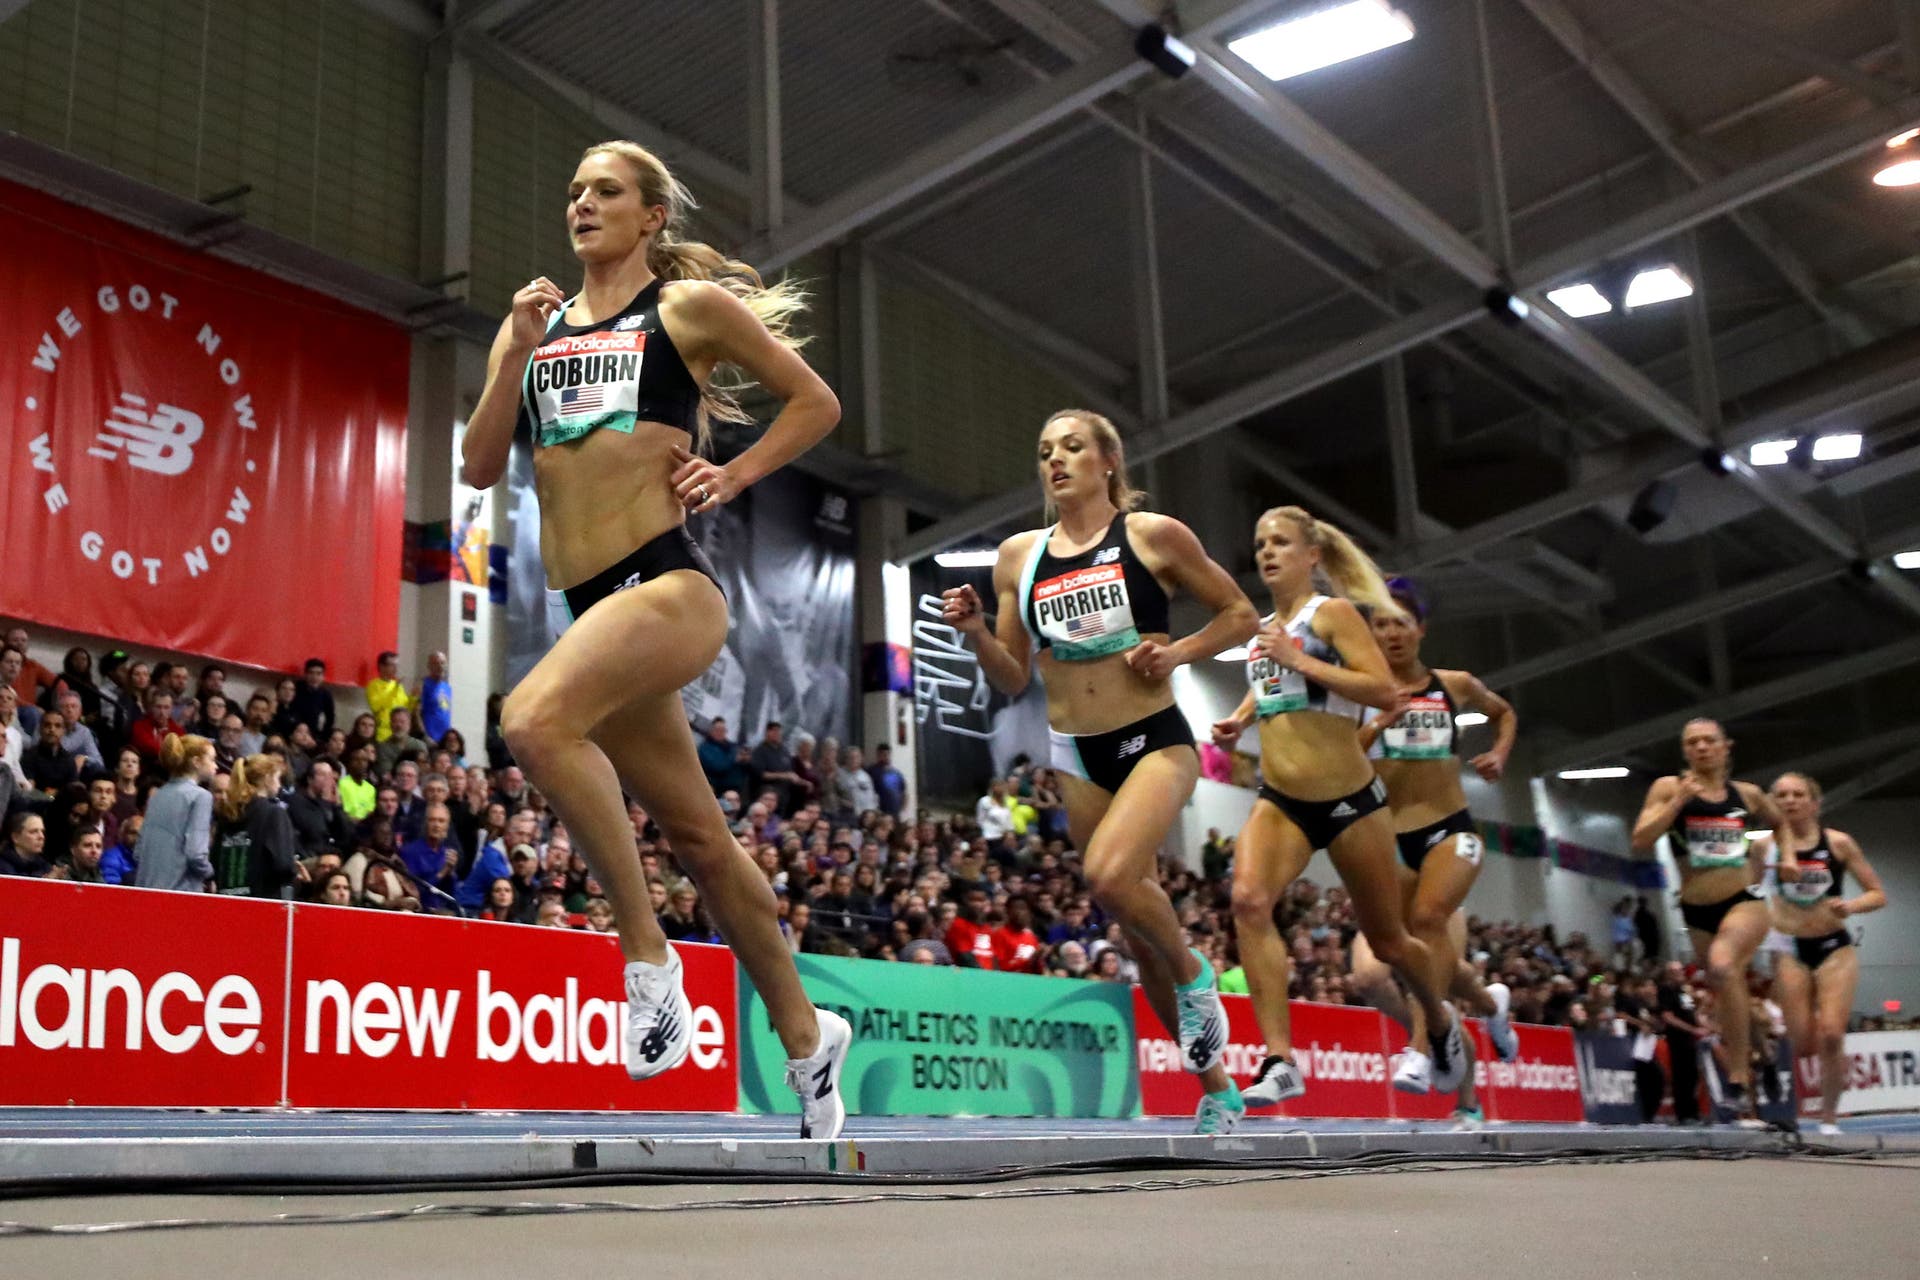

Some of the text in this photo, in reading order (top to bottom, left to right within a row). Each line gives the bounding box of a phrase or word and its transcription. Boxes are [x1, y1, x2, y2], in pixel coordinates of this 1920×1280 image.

[32, 284, 257, 431] WE GOT NOW
[537, 336, 636, 356] new balance
[536, 353, 638, 393] COBURN
[28, 432, 251, 586] WE GOT NOW
[1038, 569, 1117, 597] new balance
[1039, 583, 1125, 626] PURRIER
[1252, 658, 1293, 681] SCO
[1389, 711, 1450, 728] ARCIA
[304, 978, 461, 1058] new
[476, 969, 726, 1070] balae
[860, 1007, 978, 1047] ATHLETICS
[989, 1015, 1065, 1051] INDOOR
[1068, 1021, 1121, 1053] TOUR
[913, 1053, 1009, 1092] BOSTON
[1310, 1040, 1385, 1083] balance
